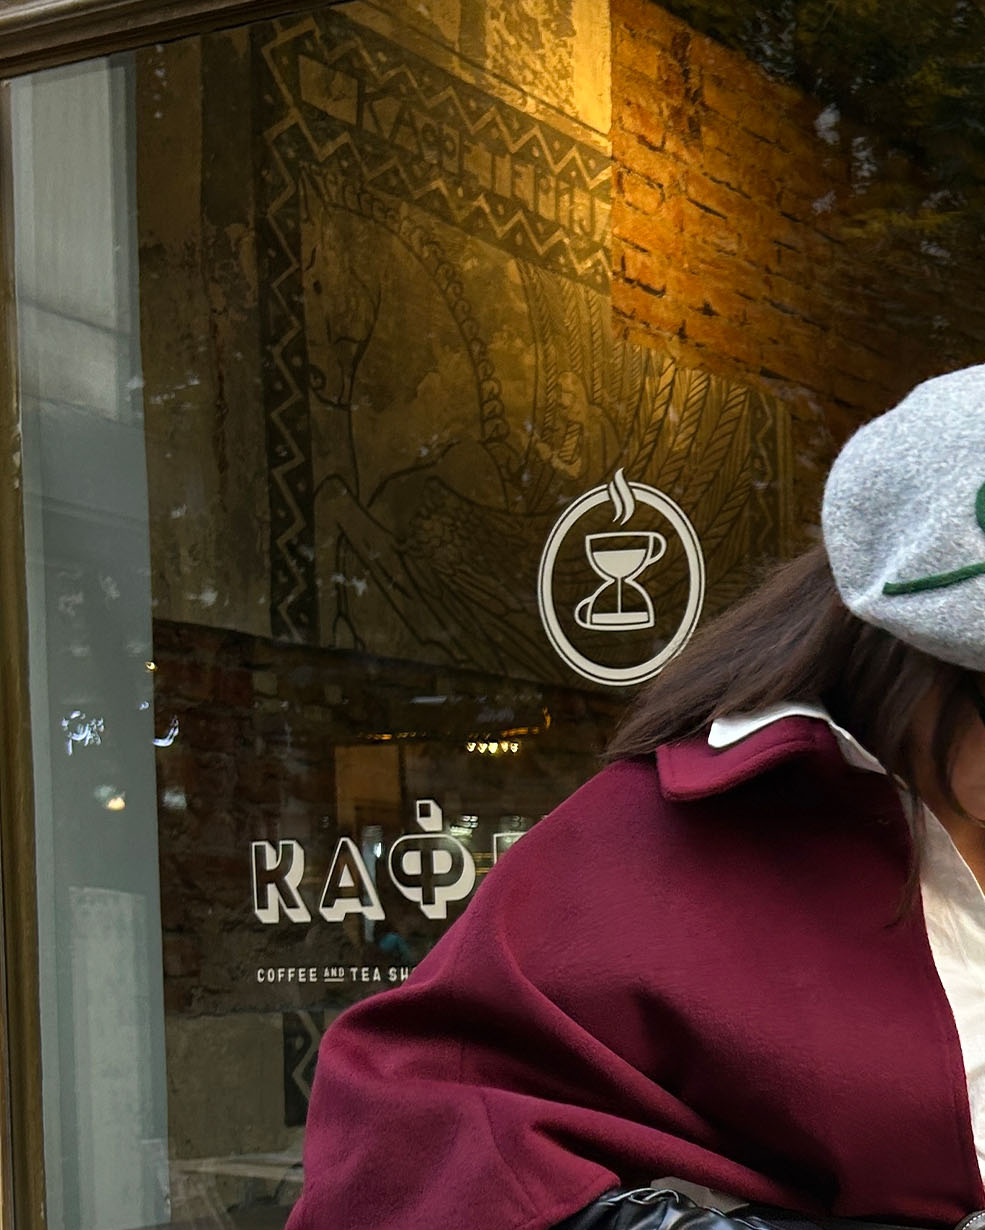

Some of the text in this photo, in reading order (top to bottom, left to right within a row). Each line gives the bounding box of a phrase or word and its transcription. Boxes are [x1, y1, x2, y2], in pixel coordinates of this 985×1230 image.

[251, 800, 527, 923] КАФ
[257, 966, 415, 982] COFFEE AND TEA SH
